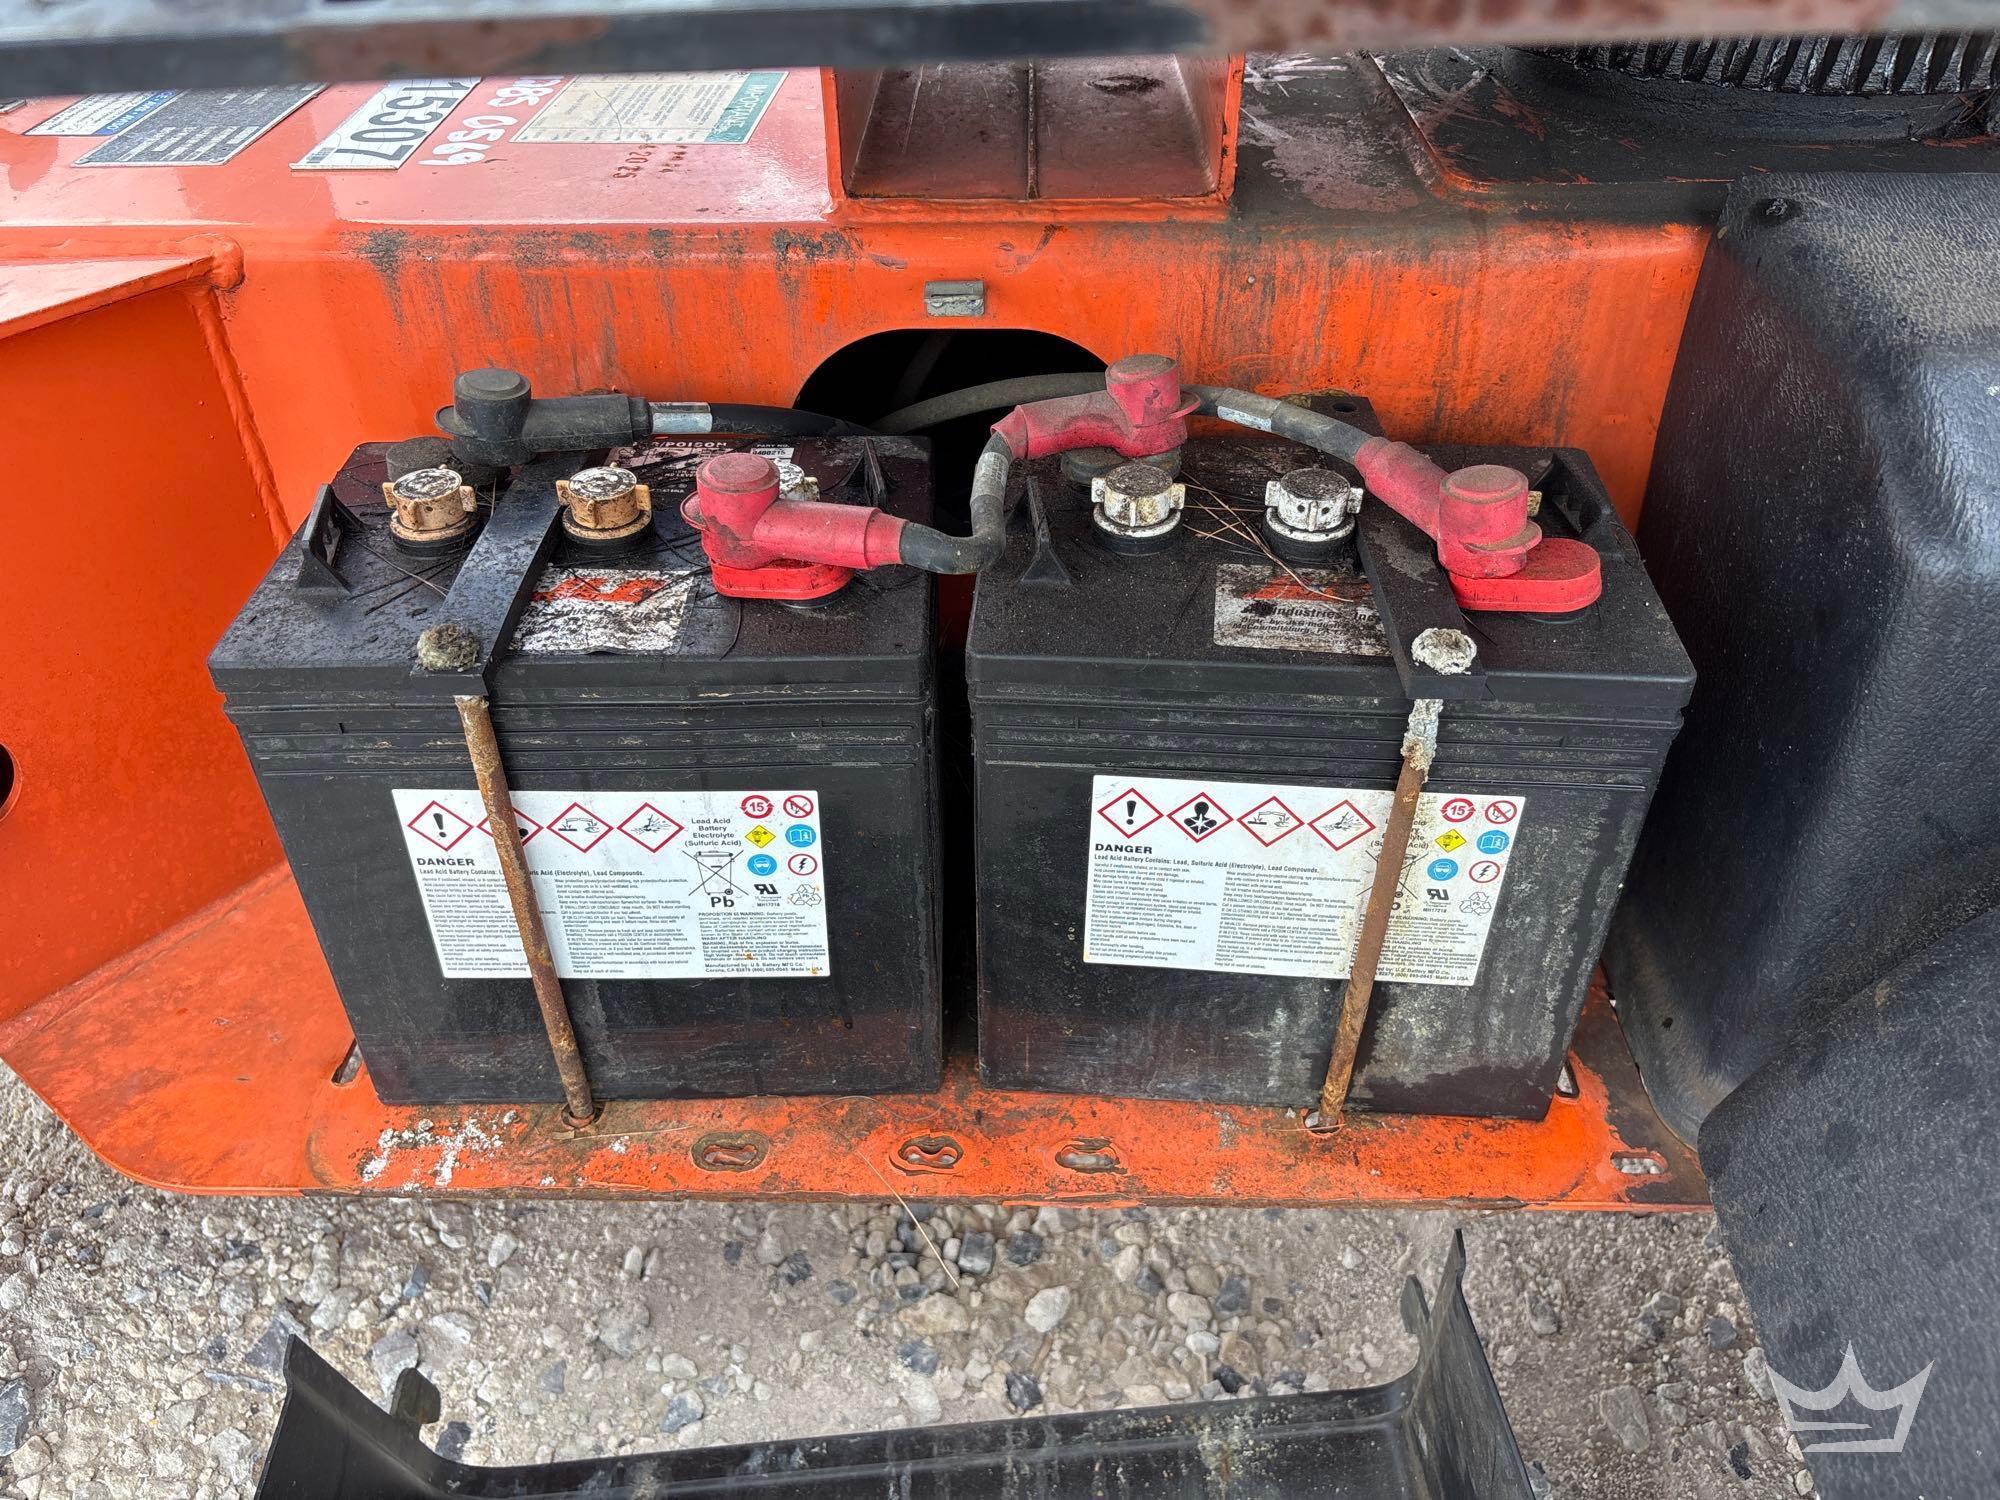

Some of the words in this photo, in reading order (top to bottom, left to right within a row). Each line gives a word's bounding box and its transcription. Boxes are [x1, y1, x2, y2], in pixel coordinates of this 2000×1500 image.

[728, 83, 769, 130] IMPORTANT
[416, 115, 519, 167] 0569
[749, 802, 764, 812] 15
[1450, 805, 1466, 816] 15
[1095, 843, 1153, 855] DANGER
[416, 857, 476, 866] DANGER
[1190, 859, 1213, 867] Sulfuric
[1228, 861, 1267, 871] (Electrolyte),
[1283, 865, 1320, 873] Compounds.
[710, 896, 735, 908] Pb
